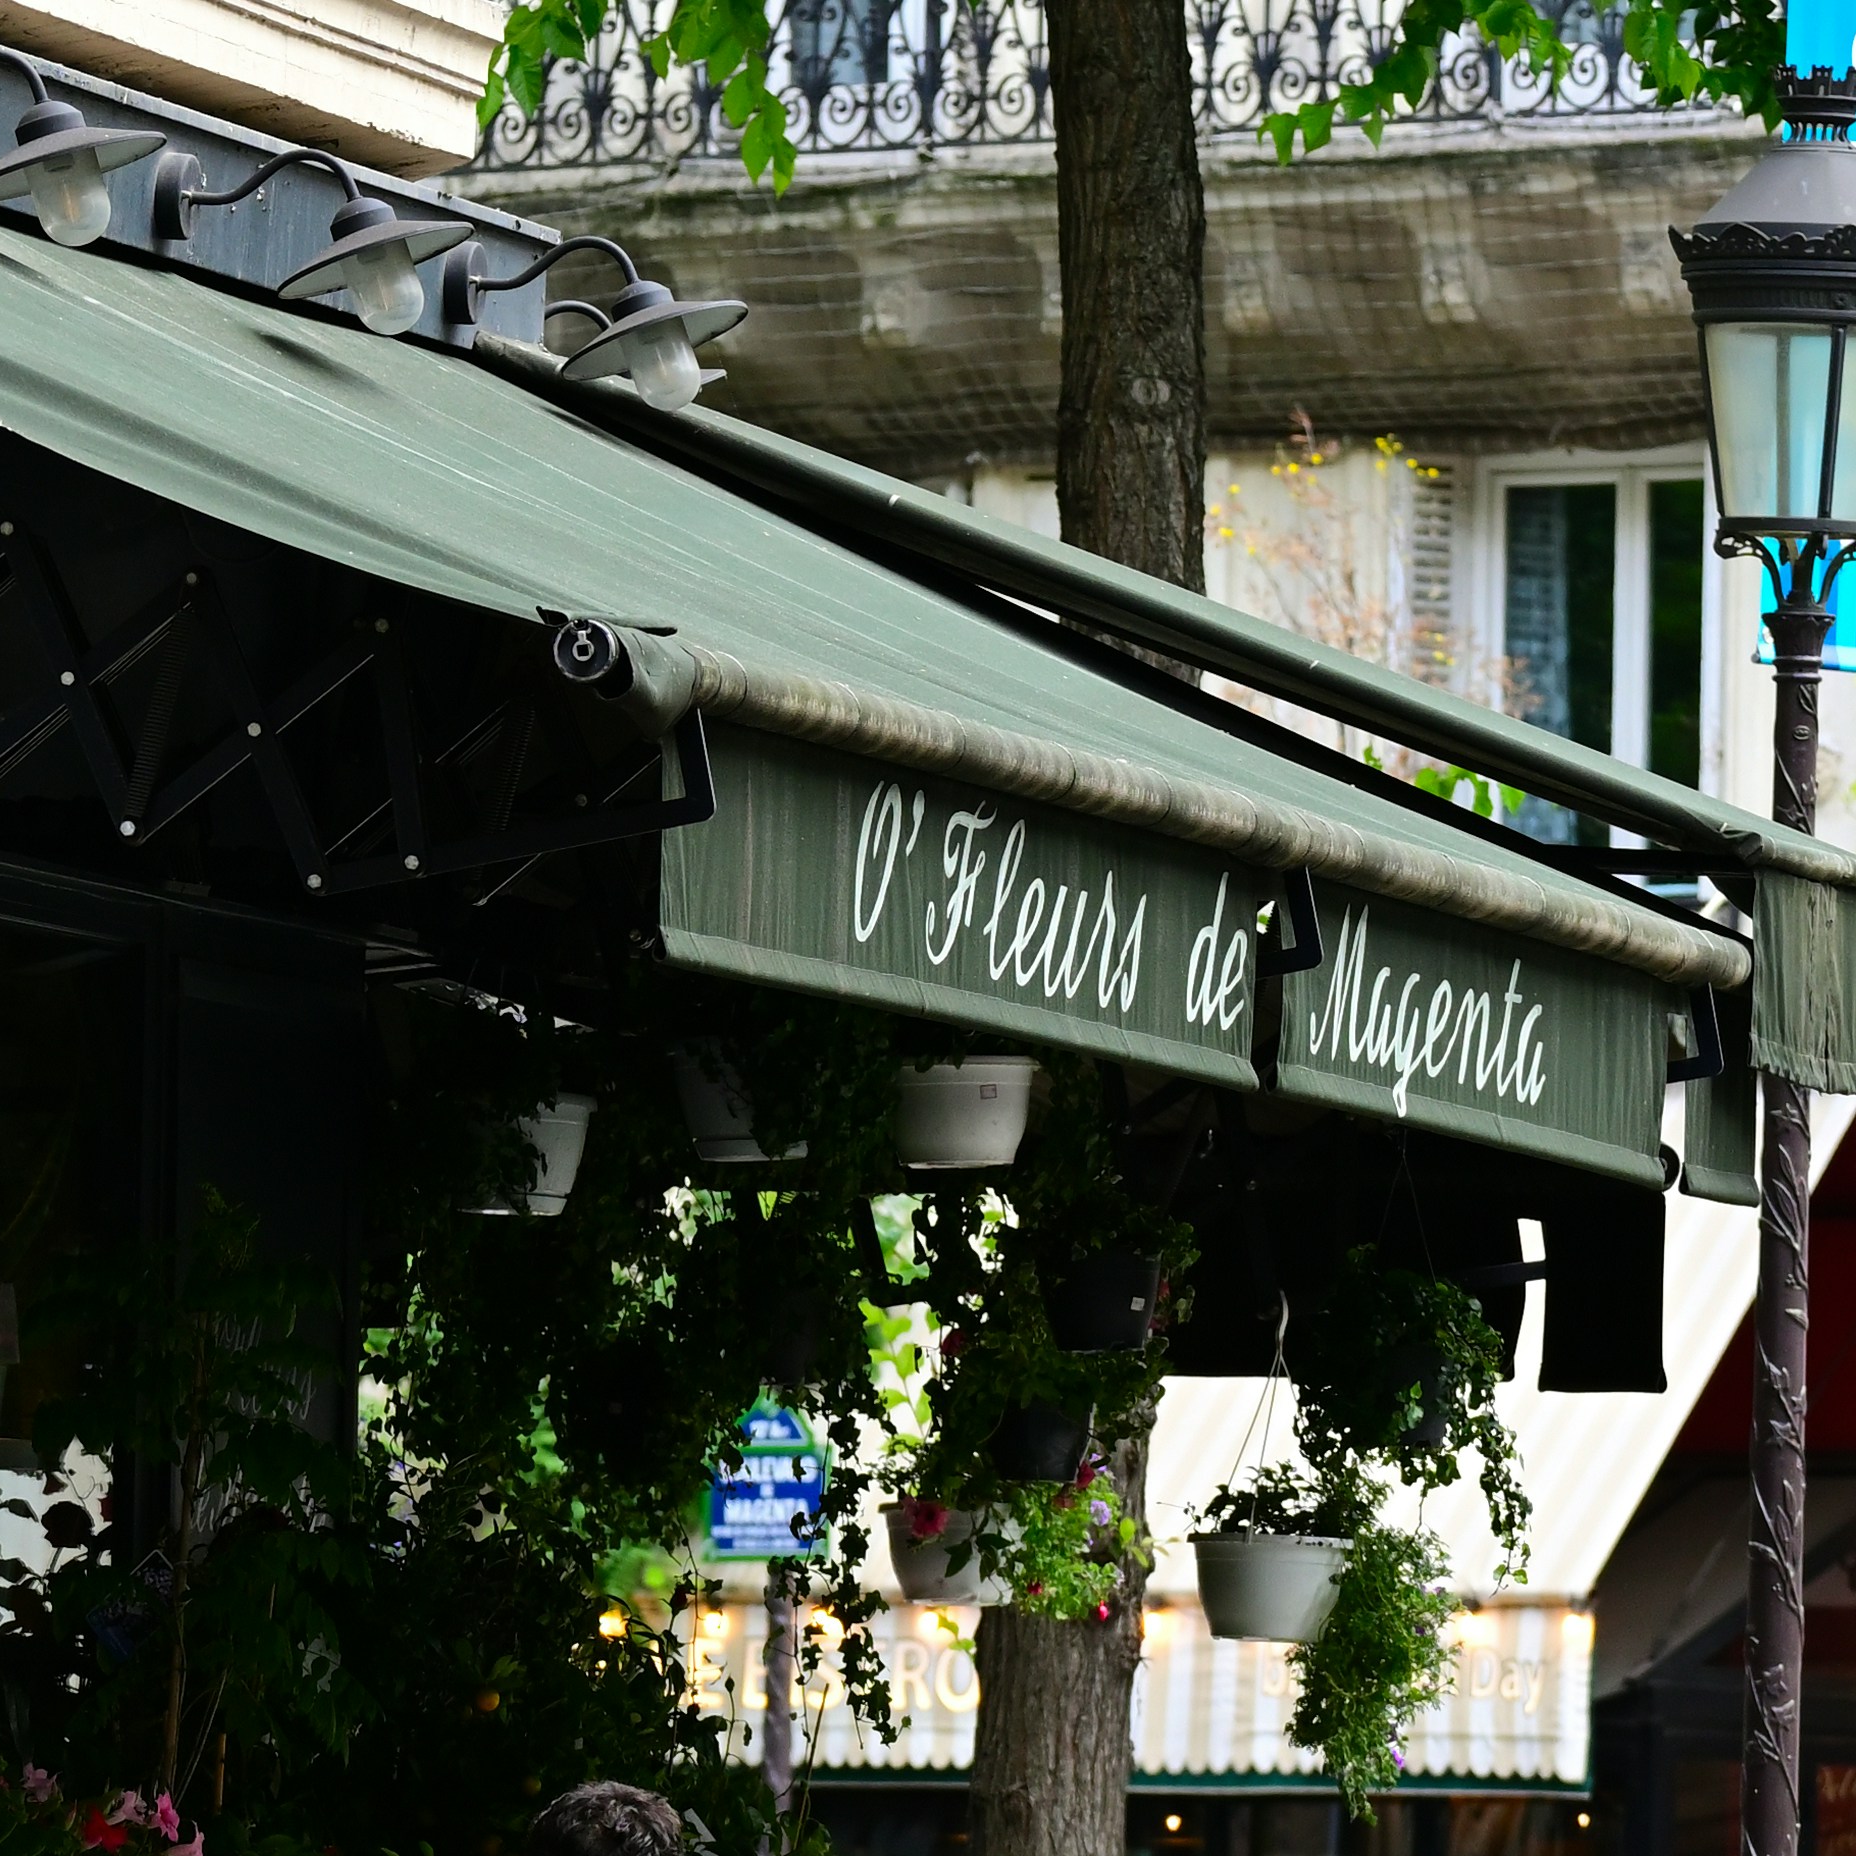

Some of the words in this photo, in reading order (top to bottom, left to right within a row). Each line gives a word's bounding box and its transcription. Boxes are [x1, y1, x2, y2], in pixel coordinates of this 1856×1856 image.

[1186, 872, 1248, 1032] de
[1310, 904, 1546, 1118] Magenta
[1471, 1648, 1545, 1716] Day
